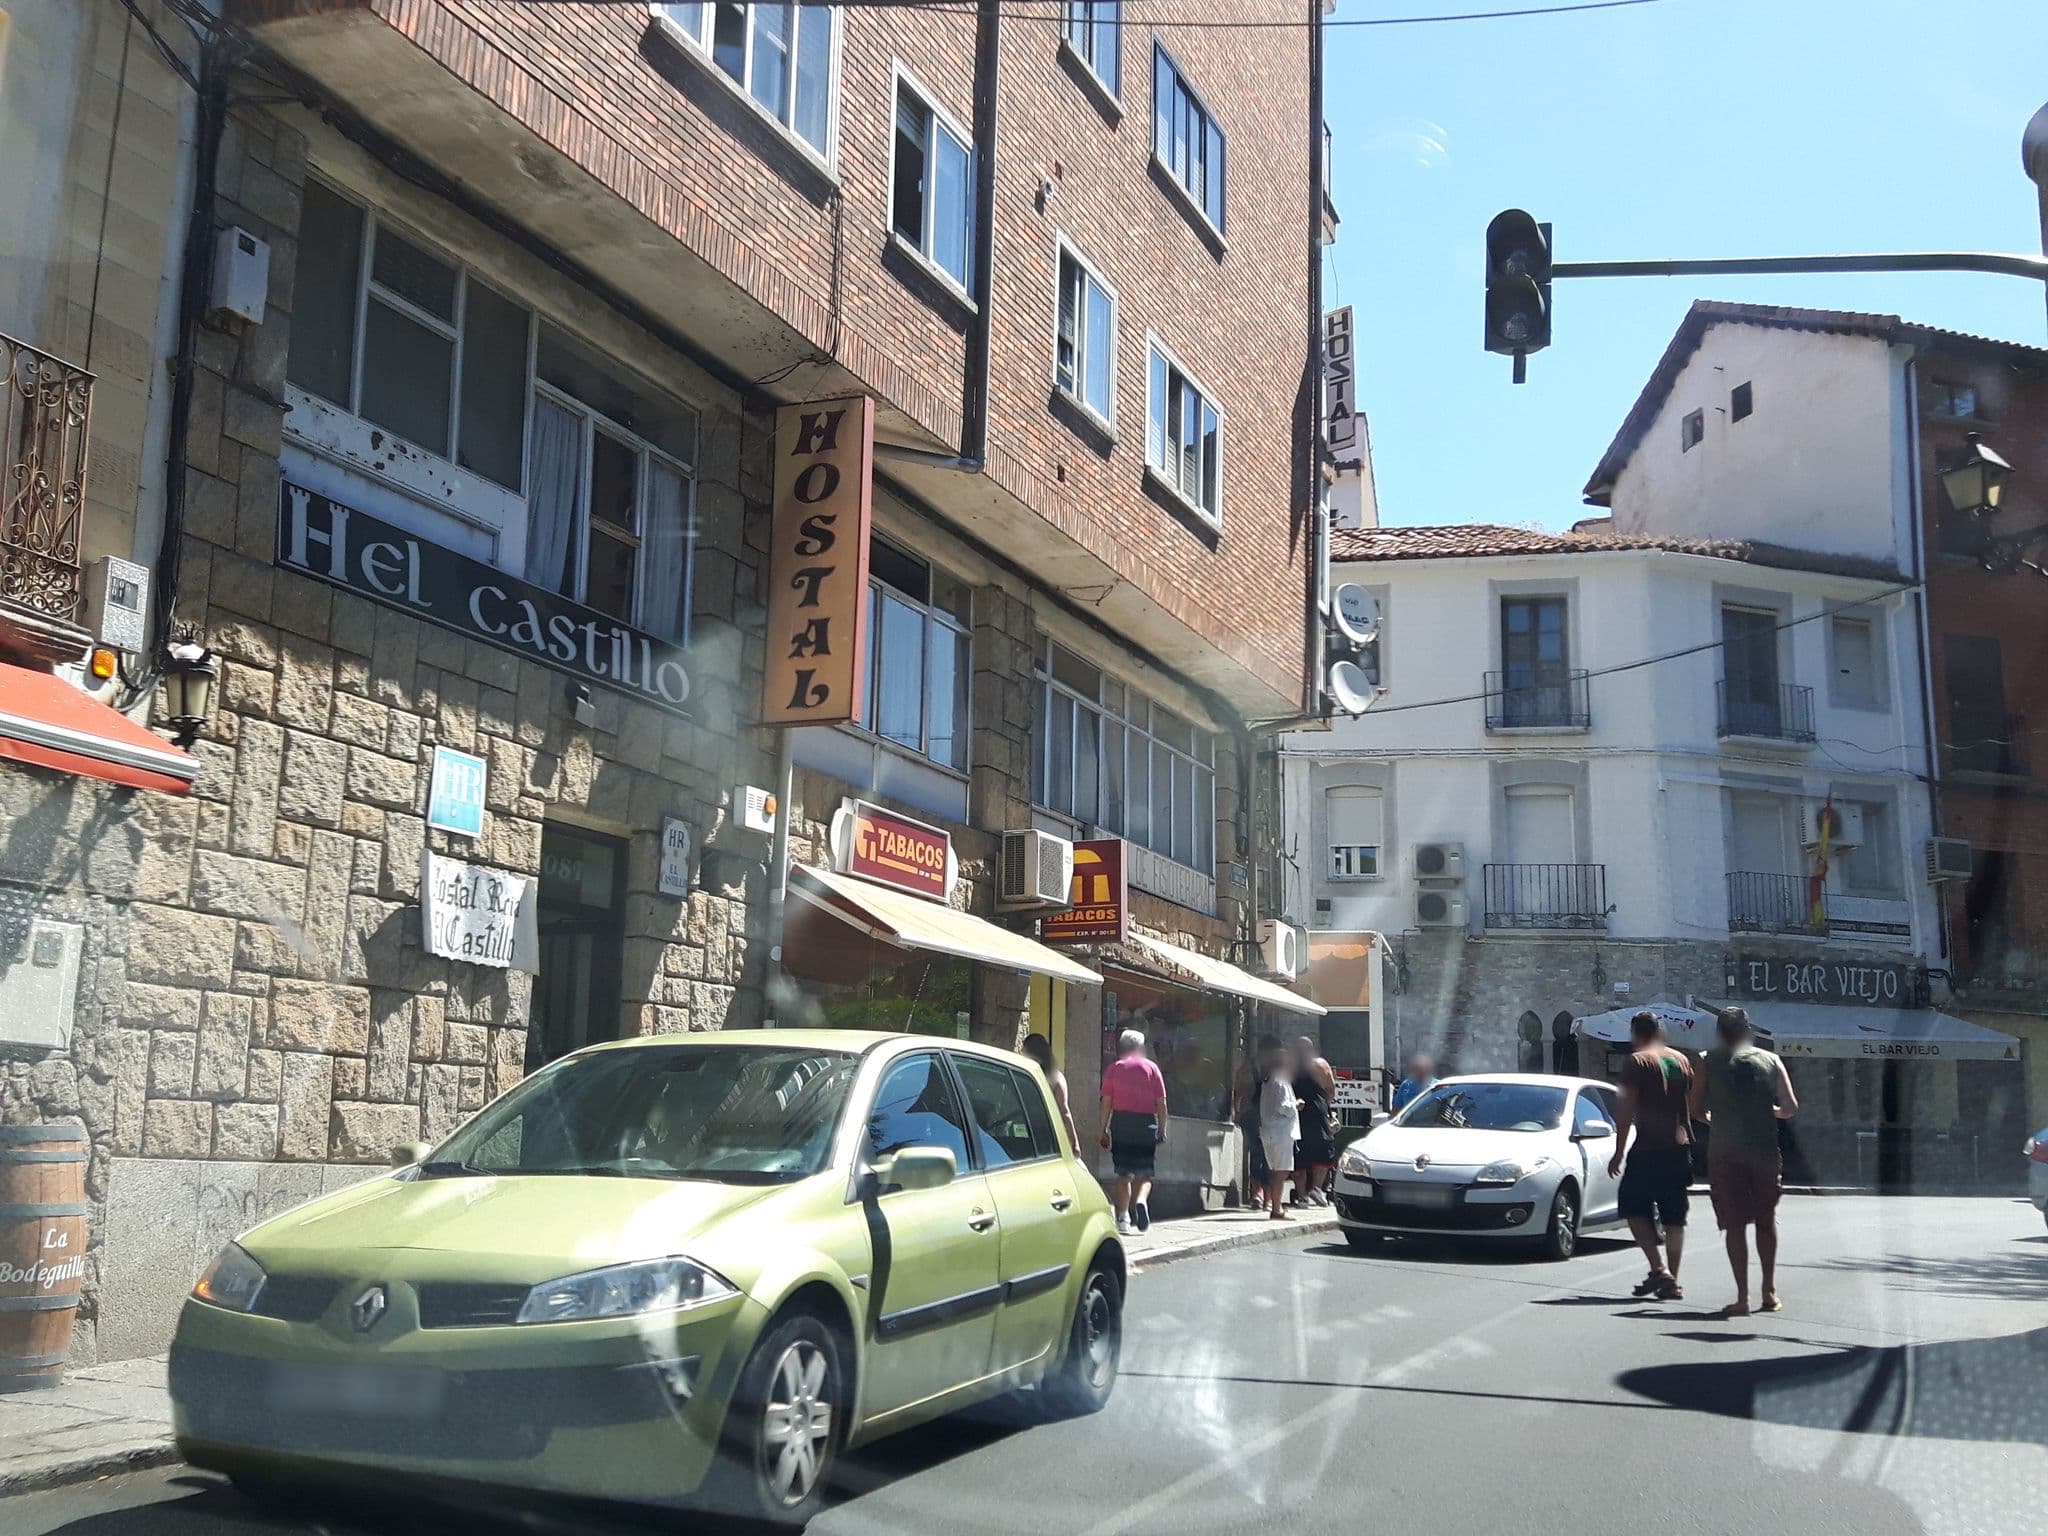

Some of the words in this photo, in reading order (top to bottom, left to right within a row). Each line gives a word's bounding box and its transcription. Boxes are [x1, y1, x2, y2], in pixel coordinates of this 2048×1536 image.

[1328, 312, 1355, 445] HOSTAL
[786, 409, 846, 709] HOSTAL
[668, 828, 685, 849] HR
[878, 827, 944, 870] TABACOS
[1748, 961, 1777, 993] EL
[1785, 963, 1828, 995] BAR
[1836, 965, 1898, 1002] VIEJO
[1862, 1044, 1876, 1054] EL
[1879, 1044, 1905, 1055] BAR
[1906, 1044, 1940, 1056] VIEJO
[43, 1228, 68, 1249] La
[0, 1252, 85, 1289] Bodeguilla
